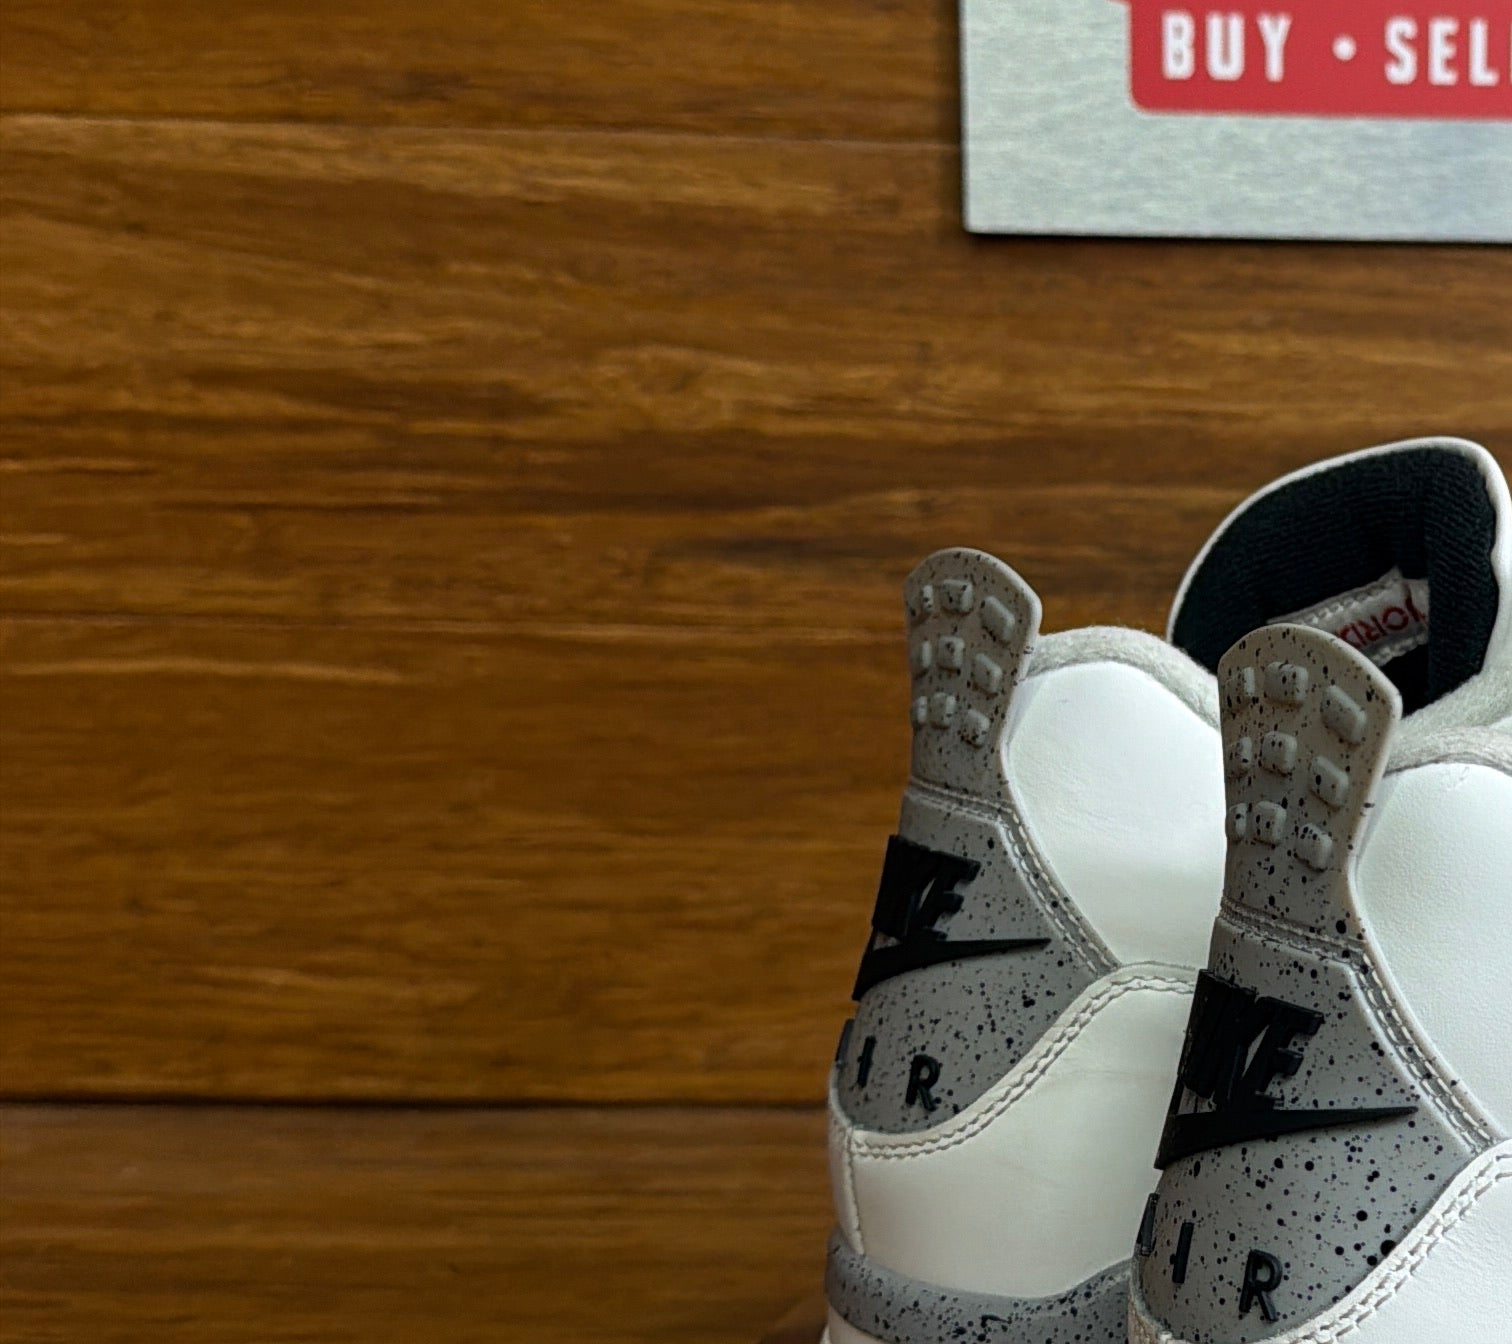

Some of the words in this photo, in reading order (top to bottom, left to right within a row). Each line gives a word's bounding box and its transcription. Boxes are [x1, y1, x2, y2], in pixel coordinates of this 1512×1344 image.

[1163, 12, 1290, 81] BUY
[1335, 581, 1427, 650] JORD
[835, 1019, 942, 1113] IR
